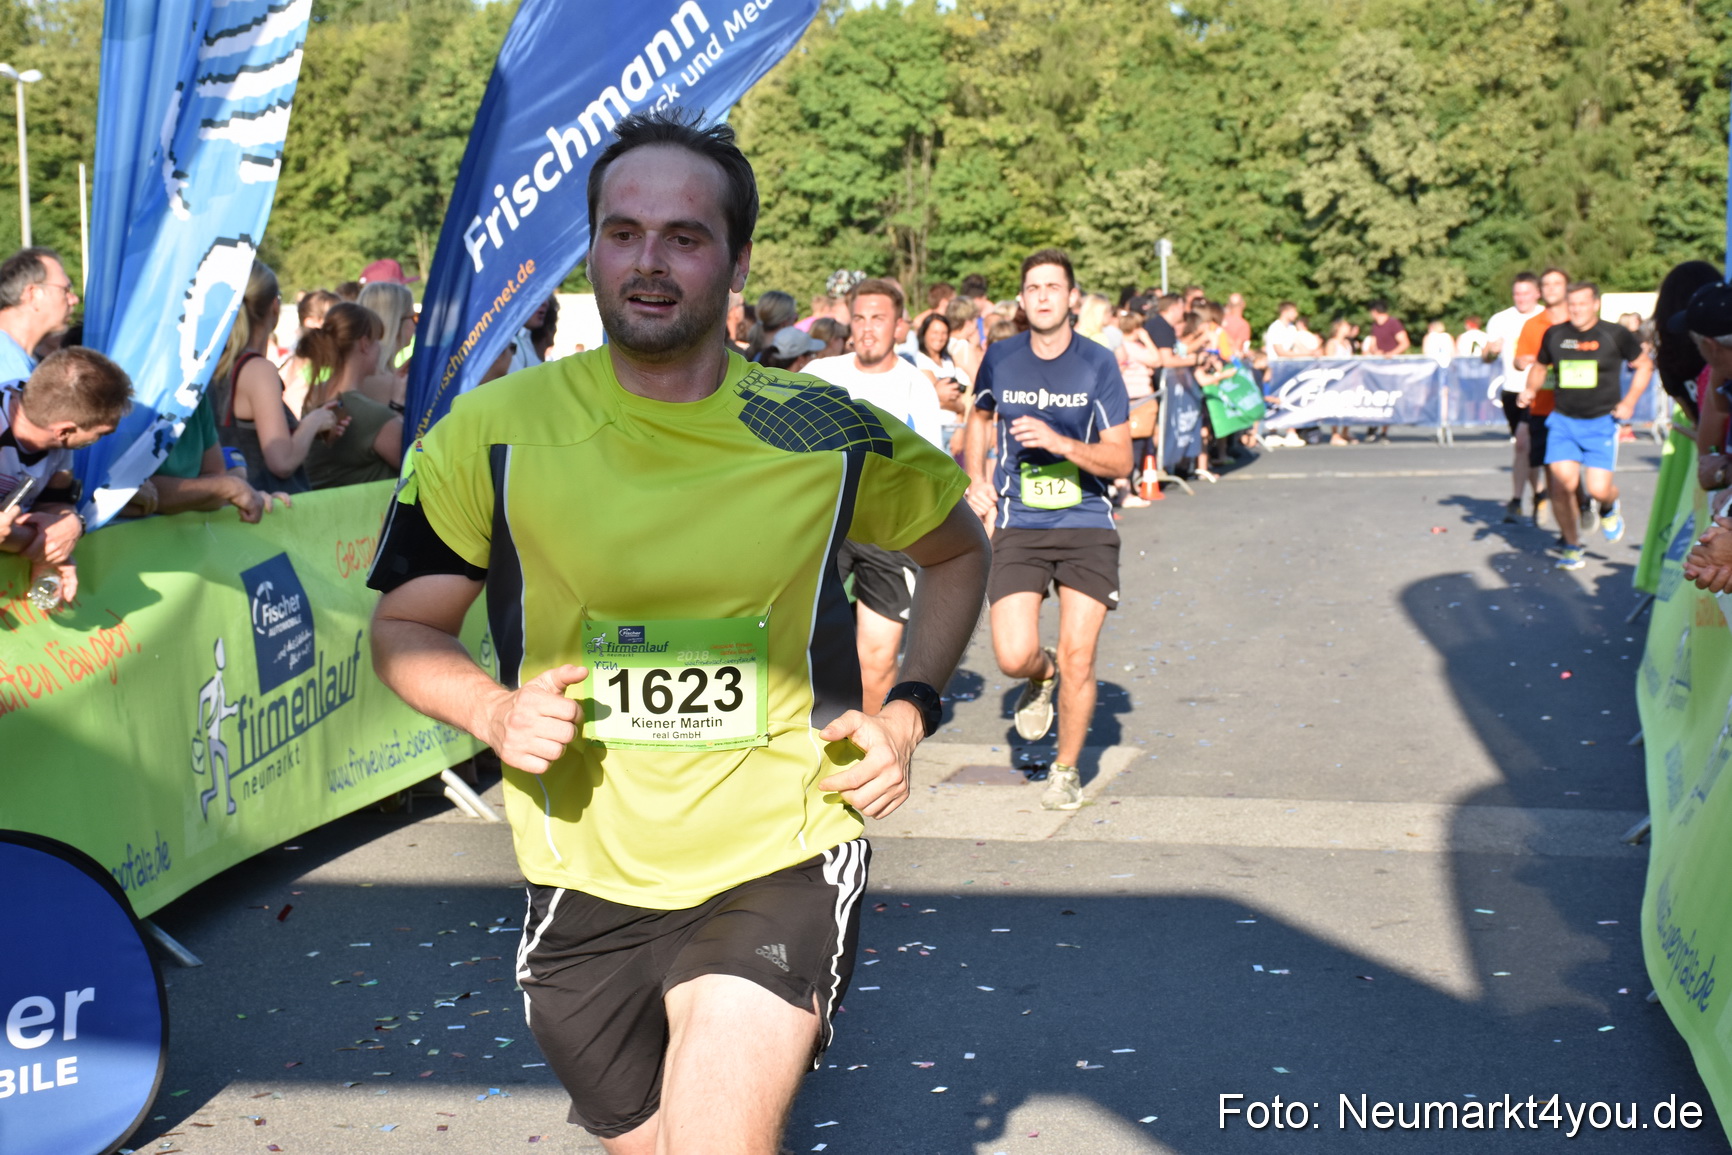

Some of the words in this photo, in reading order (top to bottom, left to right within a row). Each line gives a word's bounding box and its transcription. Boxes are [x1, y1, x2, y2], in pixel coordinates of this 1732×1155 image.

[681, 33, 724, 87] und
[723, 0, 774, 42] Me
[463, 0, 710, 273] Frischmann
[1033, 478, 1066, 497] 512
[262, 593, 301, 627] Fischer
[43, 608, 142, 686] länger!
[607, 640, 670, 653] firmenlauf
[677, 650, 710, 662] 2018
[237, 629, 364, 770] firmenlauf
[608, 666, 744, 714] 1623
[631, 717, 676, 729] Kiener
[680, 716, 723, 729] Martin
[652, 731, 670, 739] real
[672, 731, 701, 739] GmbH
[242, 742, 301, 801] neumarkt
[755, 948, 790, 972] adidas
[5, 986, 96, 1050] er
